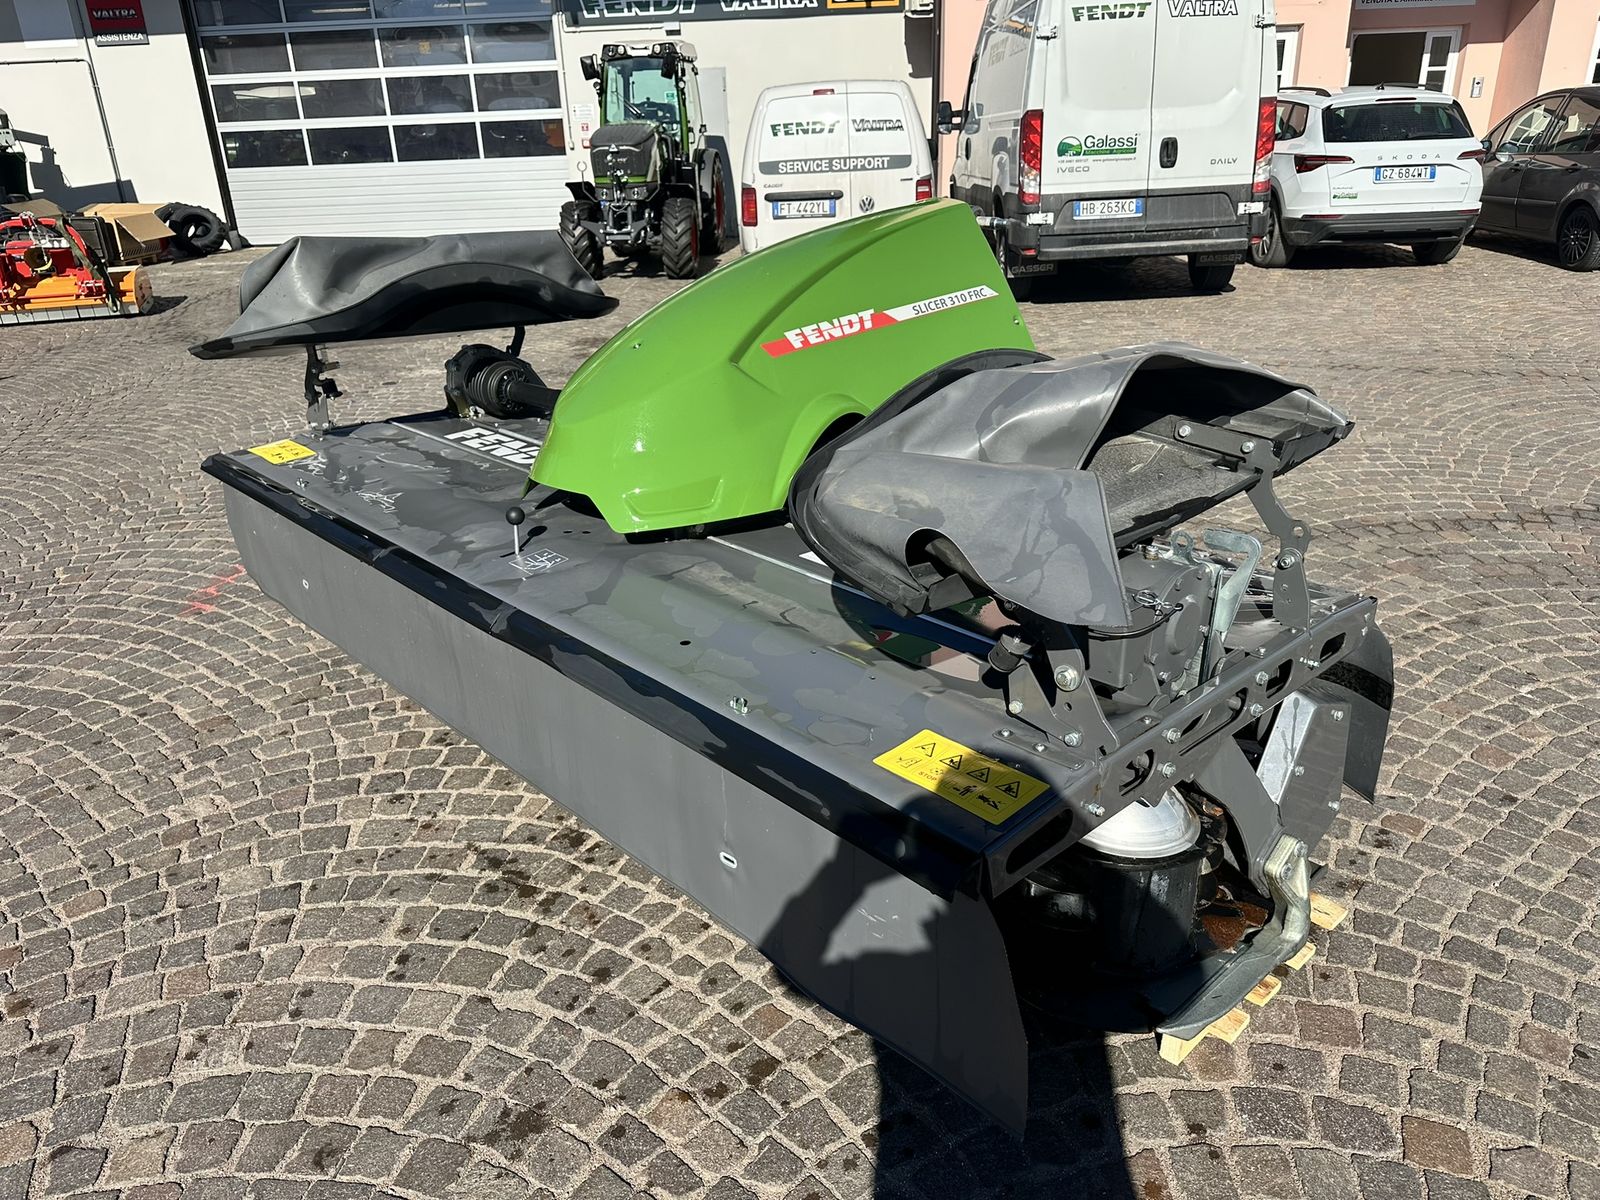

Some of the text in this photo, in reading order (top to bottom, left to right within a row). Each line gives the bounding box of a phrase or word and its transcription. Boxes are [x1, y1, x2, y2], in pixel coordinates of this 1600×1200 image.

[92, 8, 138, 19] VALTRA
[1071, 2, 1151, 22] FENDT
[1167, 0, 1238, 17] VALTRA
[96, 32, 144, 42] ASSISTENZA
[770, 120, 840, 137] FENDT
[851, 119, 904, 132] VALTRA
[1083, 133, 1138, 149] Galassi
[778, 157, 890, 174] SERVICE SUPPORT
[1081, 200, 1135, 215] HB 263KC
[1011, 263, 1055, 274] GASSER
[783, 287, 988, 349] FENDT SLICER 310 FRC
[443, 427, 541, 465] FEND
